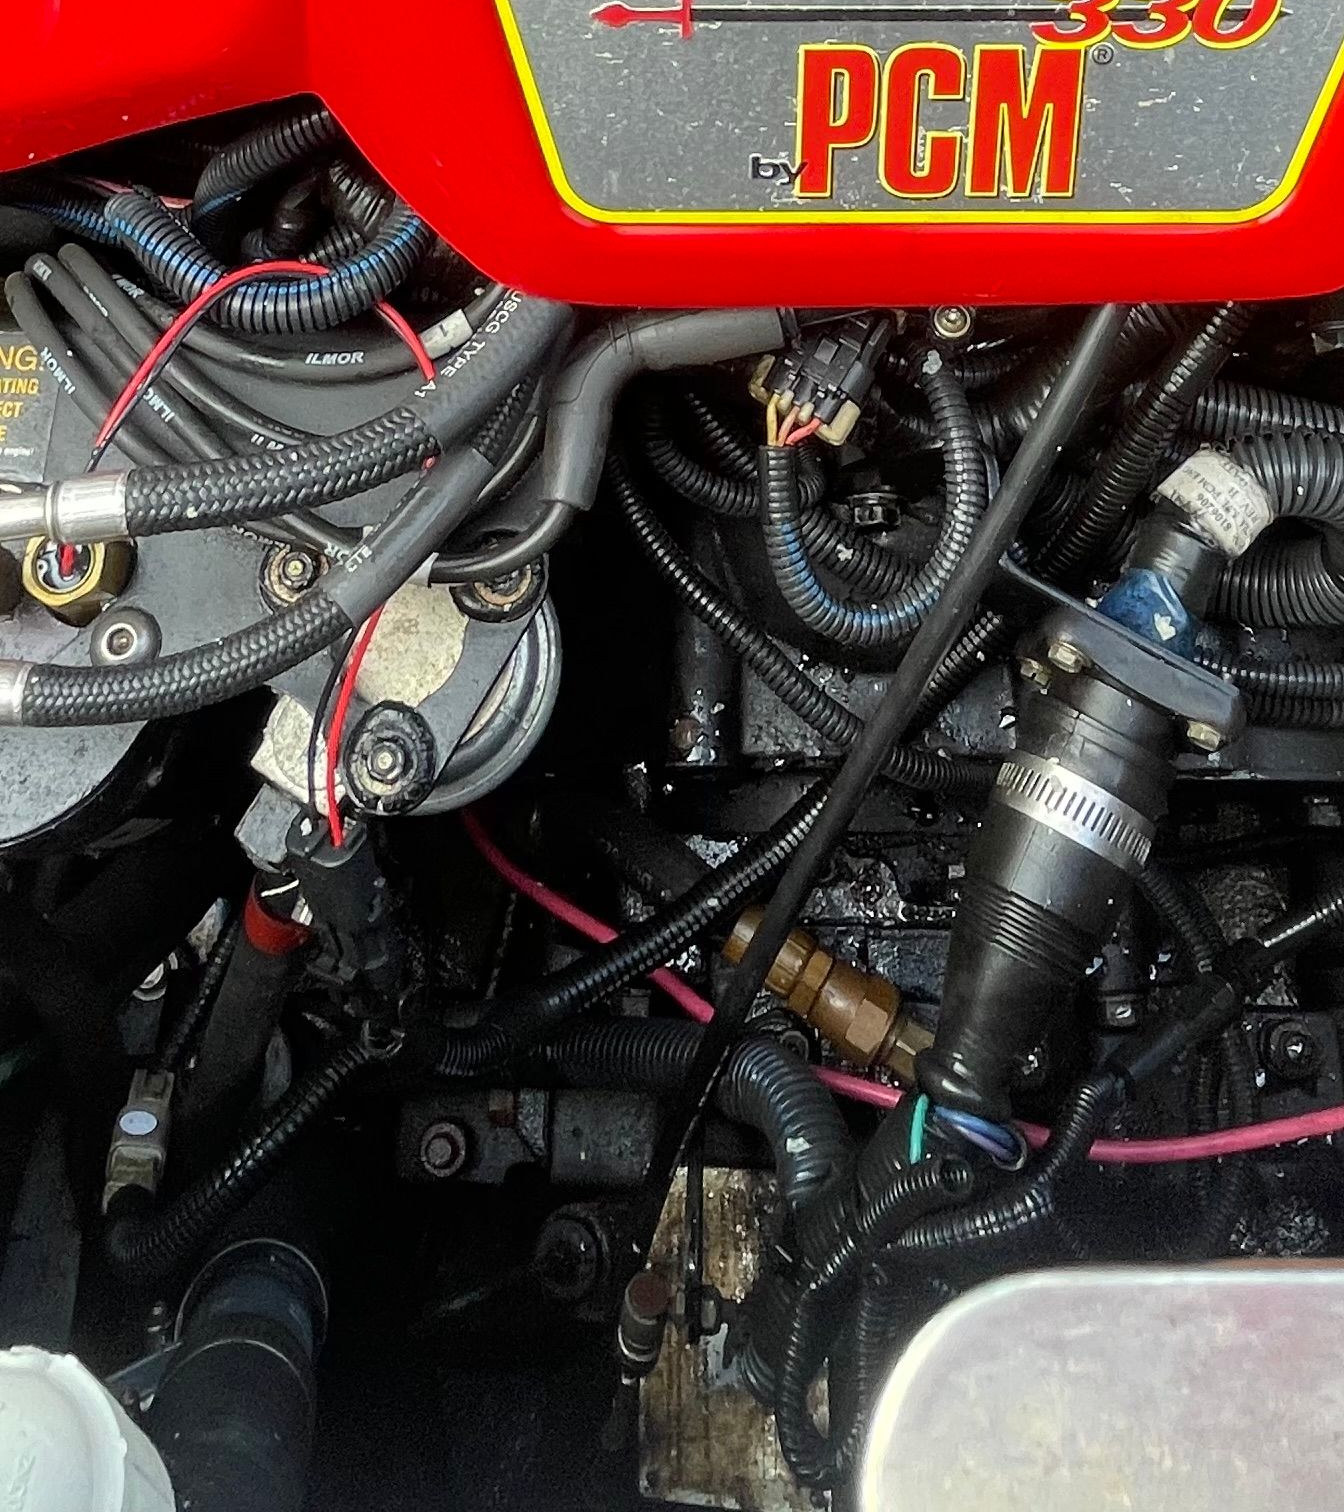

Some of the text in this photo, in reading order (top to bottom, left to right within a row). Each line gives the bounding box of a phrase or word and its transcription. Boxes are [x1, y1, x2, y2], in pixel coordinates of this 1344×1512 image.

[750, 41, 1084, 199] by PCM
[304, 350, 366, 365] ILMOR
[440, 340, 486, 379] TYPE
[137, 383, 176, 423] ILMO
